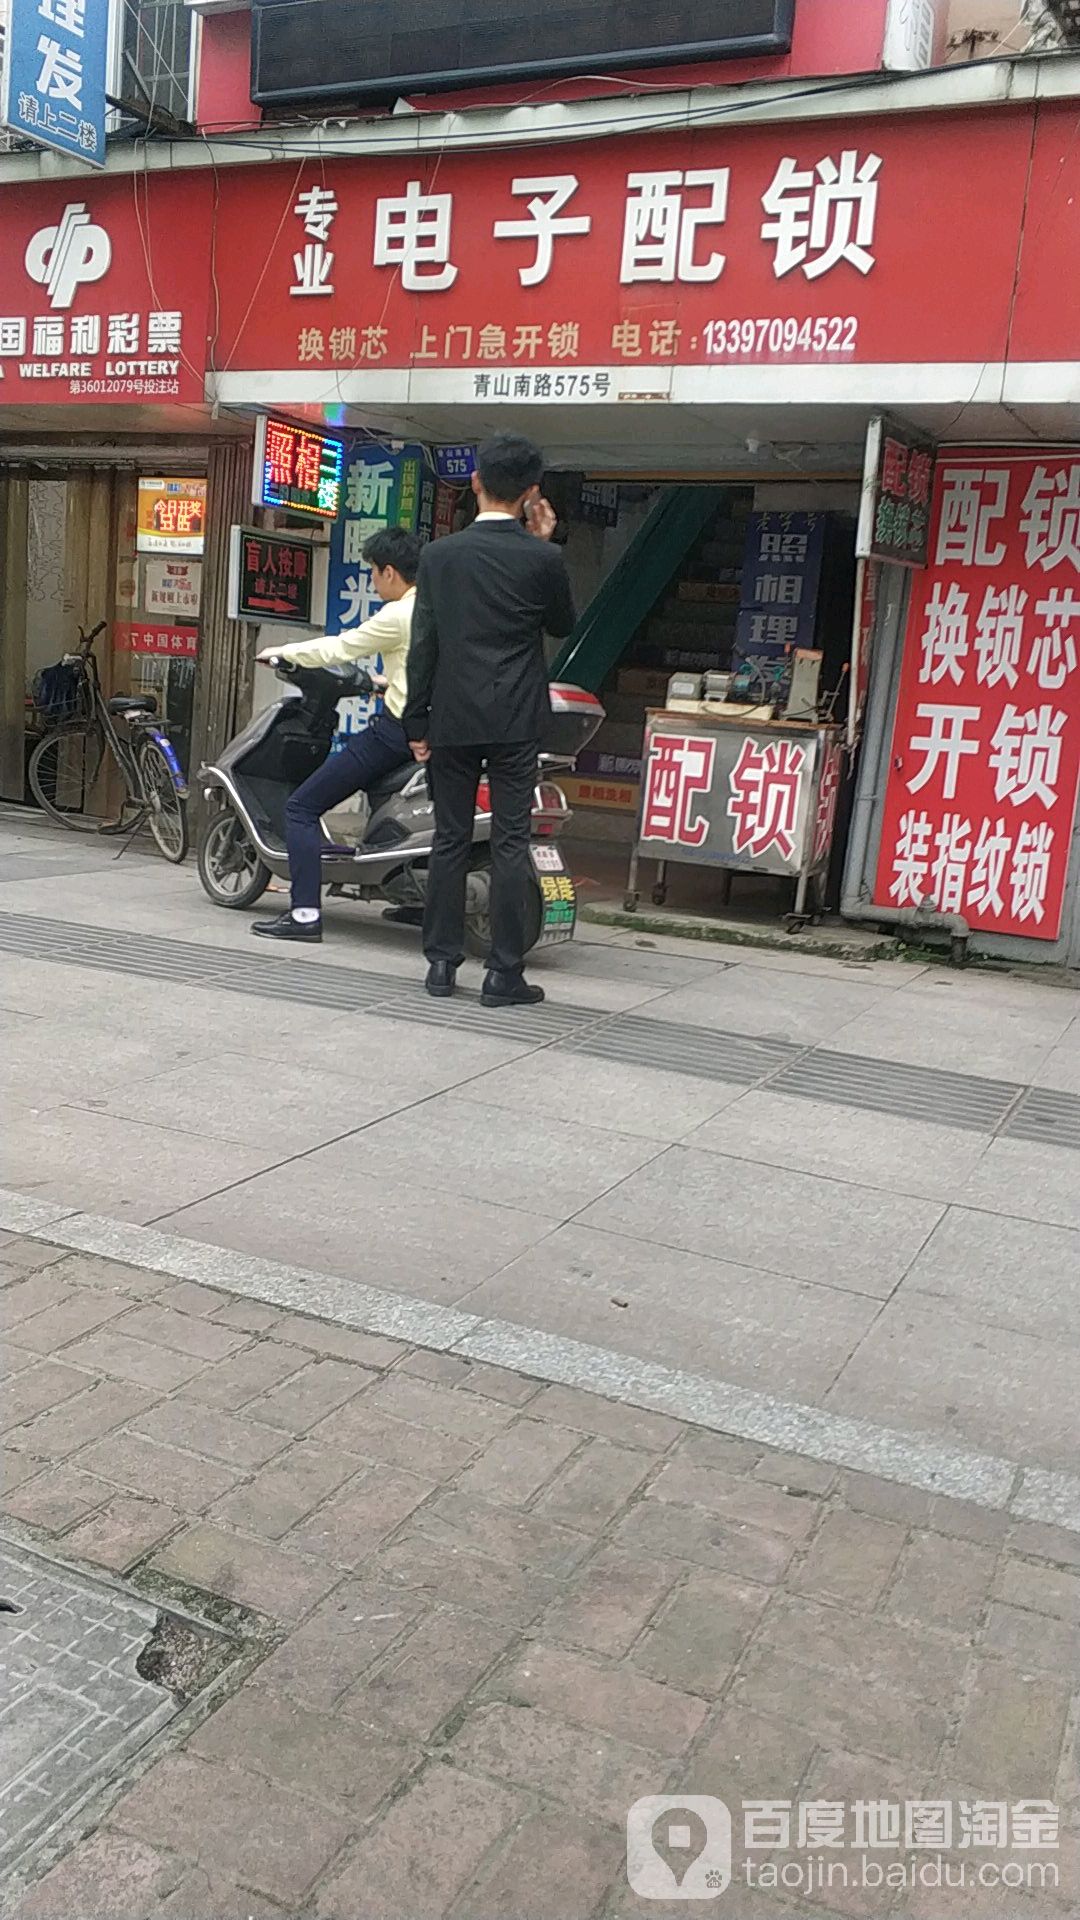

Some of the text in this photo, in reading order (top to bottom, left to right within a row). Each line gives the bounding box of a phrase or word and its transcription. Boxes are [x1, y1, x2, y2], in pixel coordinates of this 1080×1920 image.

[18, 92, 97, 152] 请上二楼
[289, 185, 338, 295] 专业
[373, 149, 884, 291] 电子配锁
[19, 362, 92, 378] WELFARE
[105, 360, 180, 377] LOTTERY
[297, 326, 389, 362] 换锁芯
[409, 321, 580, 360] 上门急开锁
[702, 316, 858, 354] 13397094522
[69, 379, 180, 395] 第36012079号投注站
[473, 372, 611, 397] 青山南路575号
[446, 459, 468, 473] 575
[153, 499, 202, 518] 今日开奖
[935, 464, 1080, 573] 配锁
[918, 581, 1080, 691] 换锁芯
[641, 733, 806, 862] 配锁
[905, 703, 1068, 810] 开锁
[889, 809, 1055, 925] 装指纹锁
